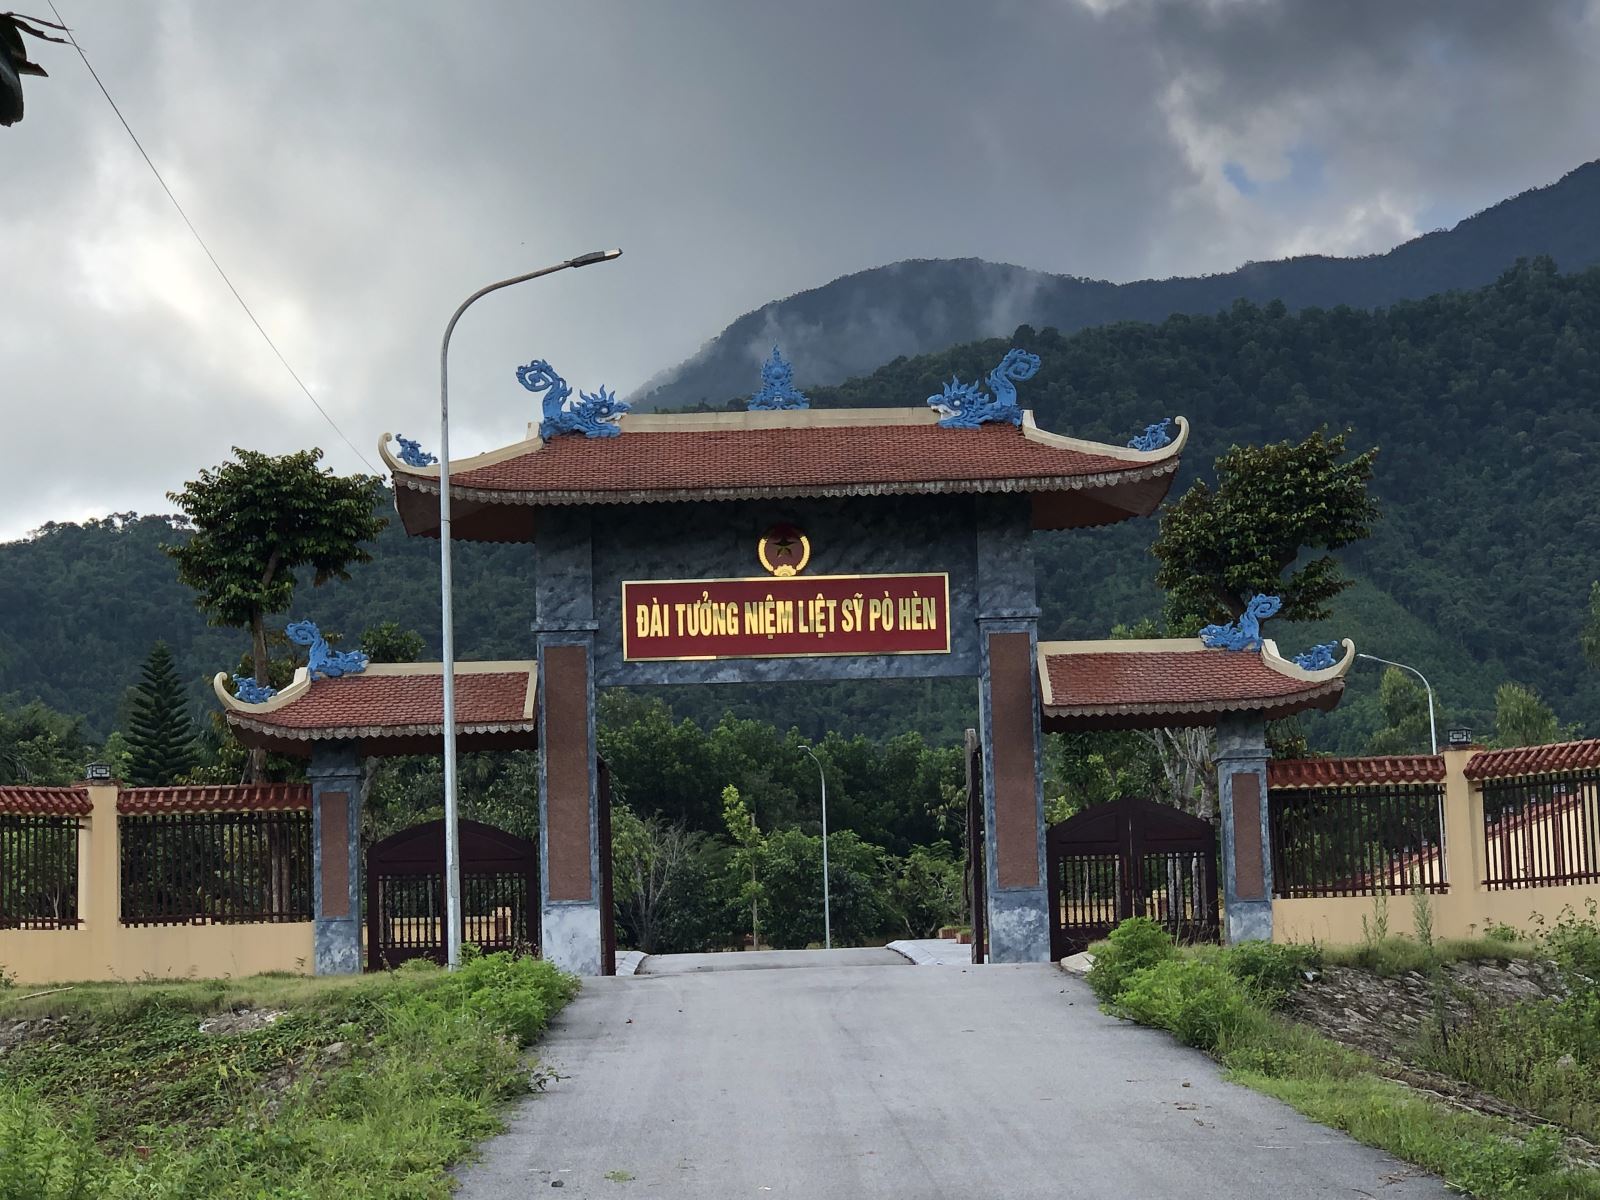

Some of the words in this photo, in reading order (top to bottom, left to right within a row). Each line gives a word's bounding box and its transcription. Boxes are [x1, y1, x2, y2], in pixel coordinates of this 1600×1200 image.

[636, 597, 669, 638] ĐÀI
[675, 590, 739, 637] TƯỞNG
[744, 594, 794, 640] NIỆM
[798, 593, 837, 638] LIỆT
[841, 592, 865, 632] SỸ
[869, 590, 893, 632] PÒ
[898, 590, 937, 631] HÈN
